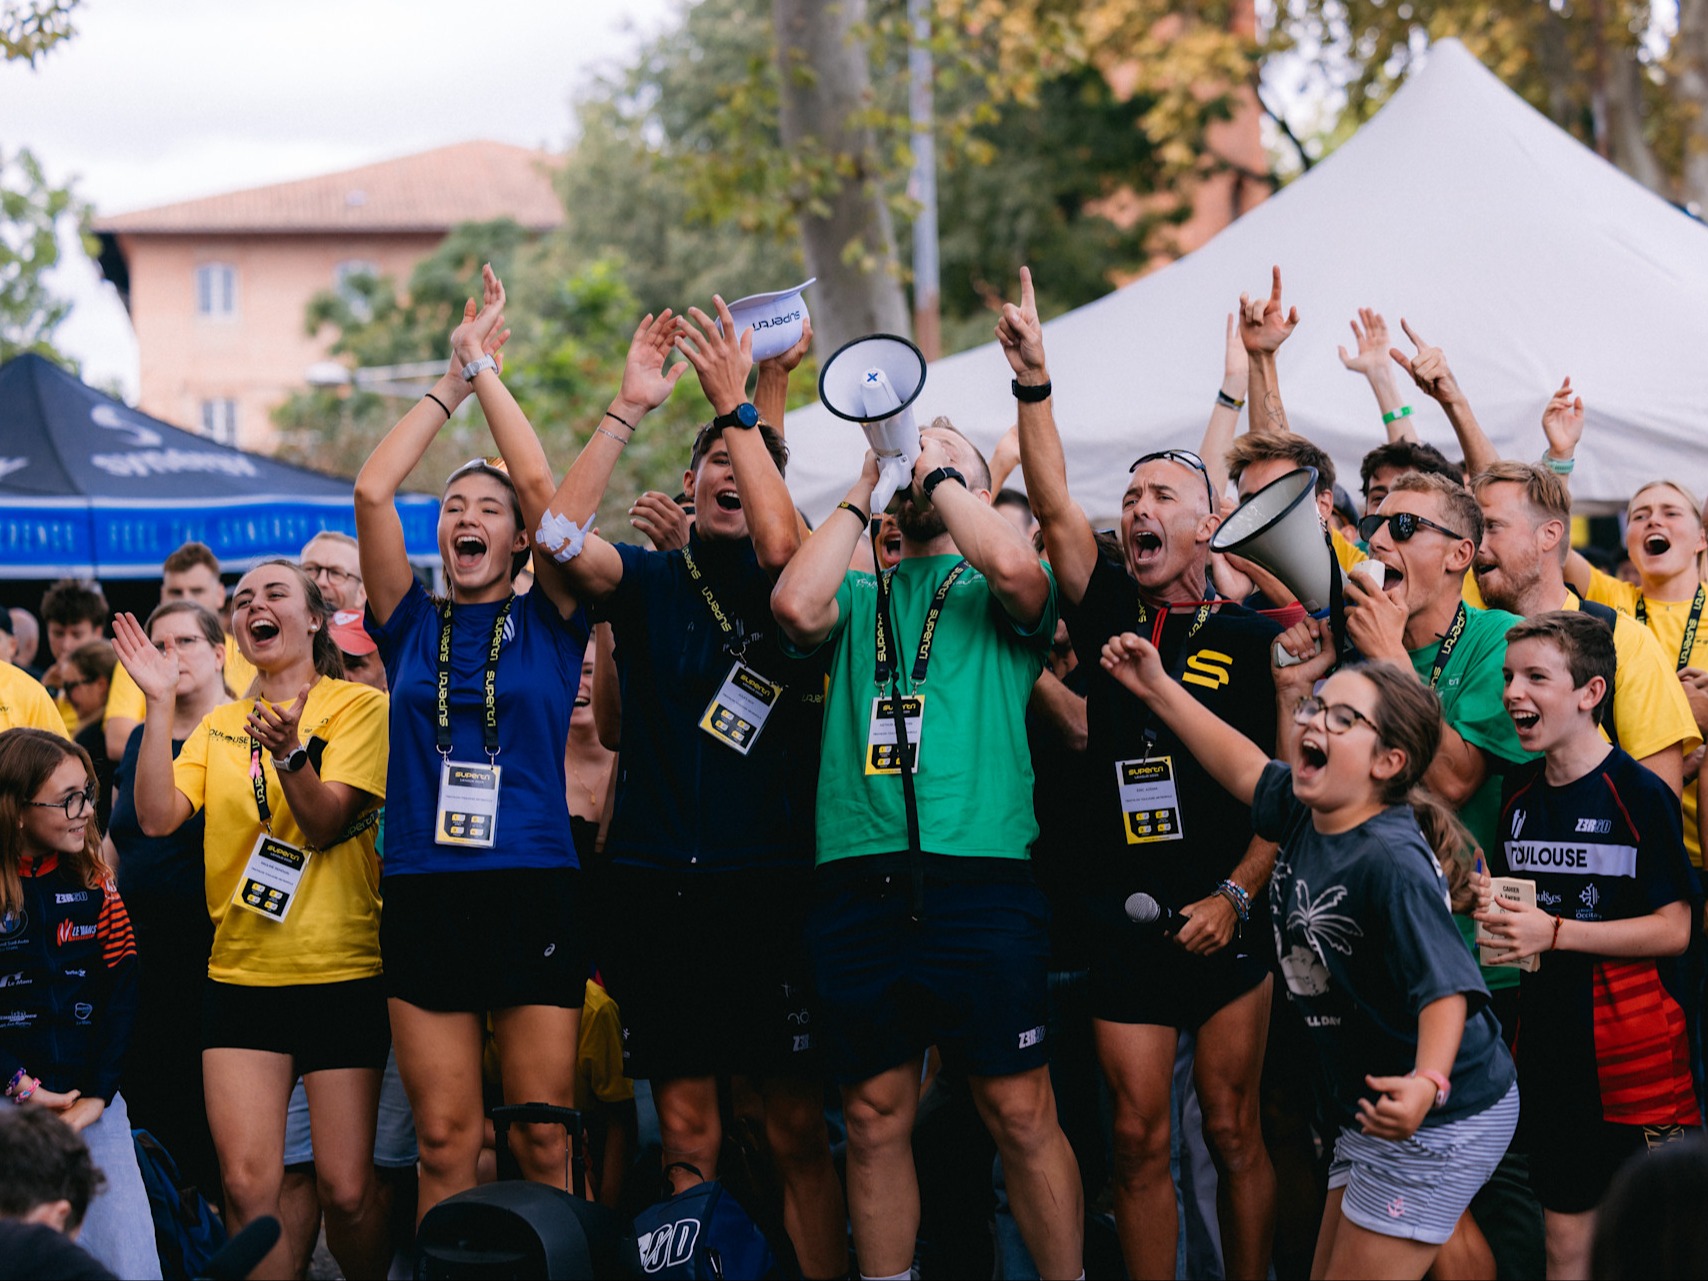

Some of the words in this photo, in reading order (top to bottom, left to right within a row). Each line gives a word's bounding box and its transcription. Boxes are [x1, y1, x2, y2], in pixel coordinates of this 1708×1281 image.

[682, 545, 702, 580] supert
[701, 585, 732, 633] supertri
[1188, 604, 1211, 638] upertri
[1441, 607, 1466, 655] upertri
[490, 616, 505, 662] supertri
[919, 608, 939, 660] supertri
[1679, 617, 1698, 665] supertri
[438, 671, 449, 727] supertri
[485, 670, 497, 727] supertri
[342, 812, 376, 839] upertri
[1511, 846, 1588, 869] TOULOUSE
[1305, 1016, 1321, 1027] LL
